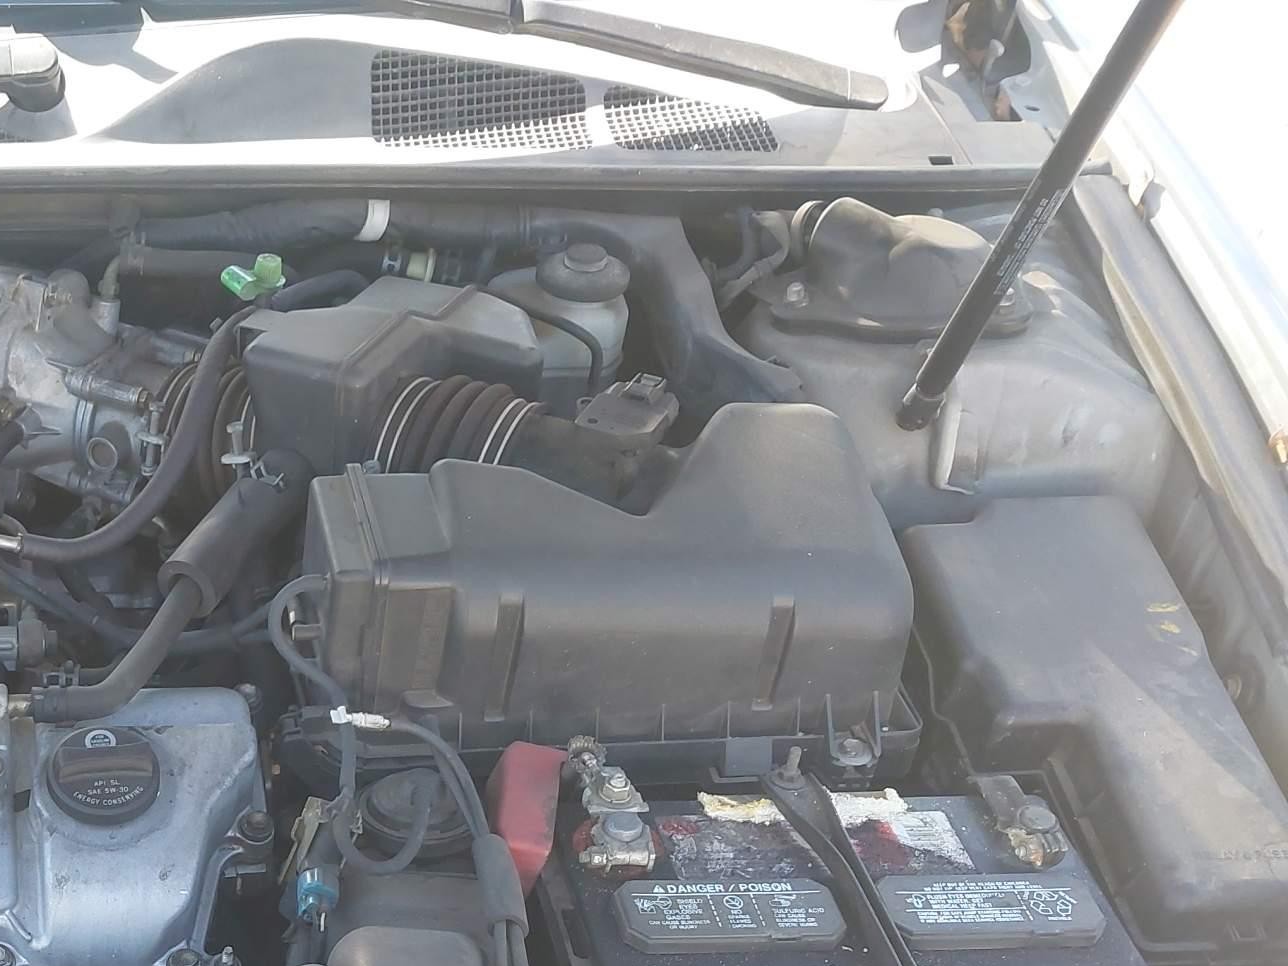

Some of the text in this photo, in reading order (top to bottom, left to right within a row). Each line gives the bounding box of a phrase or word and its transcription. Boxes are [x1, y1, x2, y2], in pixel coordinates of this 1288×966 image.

[73, 785, 144, 806] ENERGY CONSERVING
[666, 882, 793, 894] DANGER / POISON
